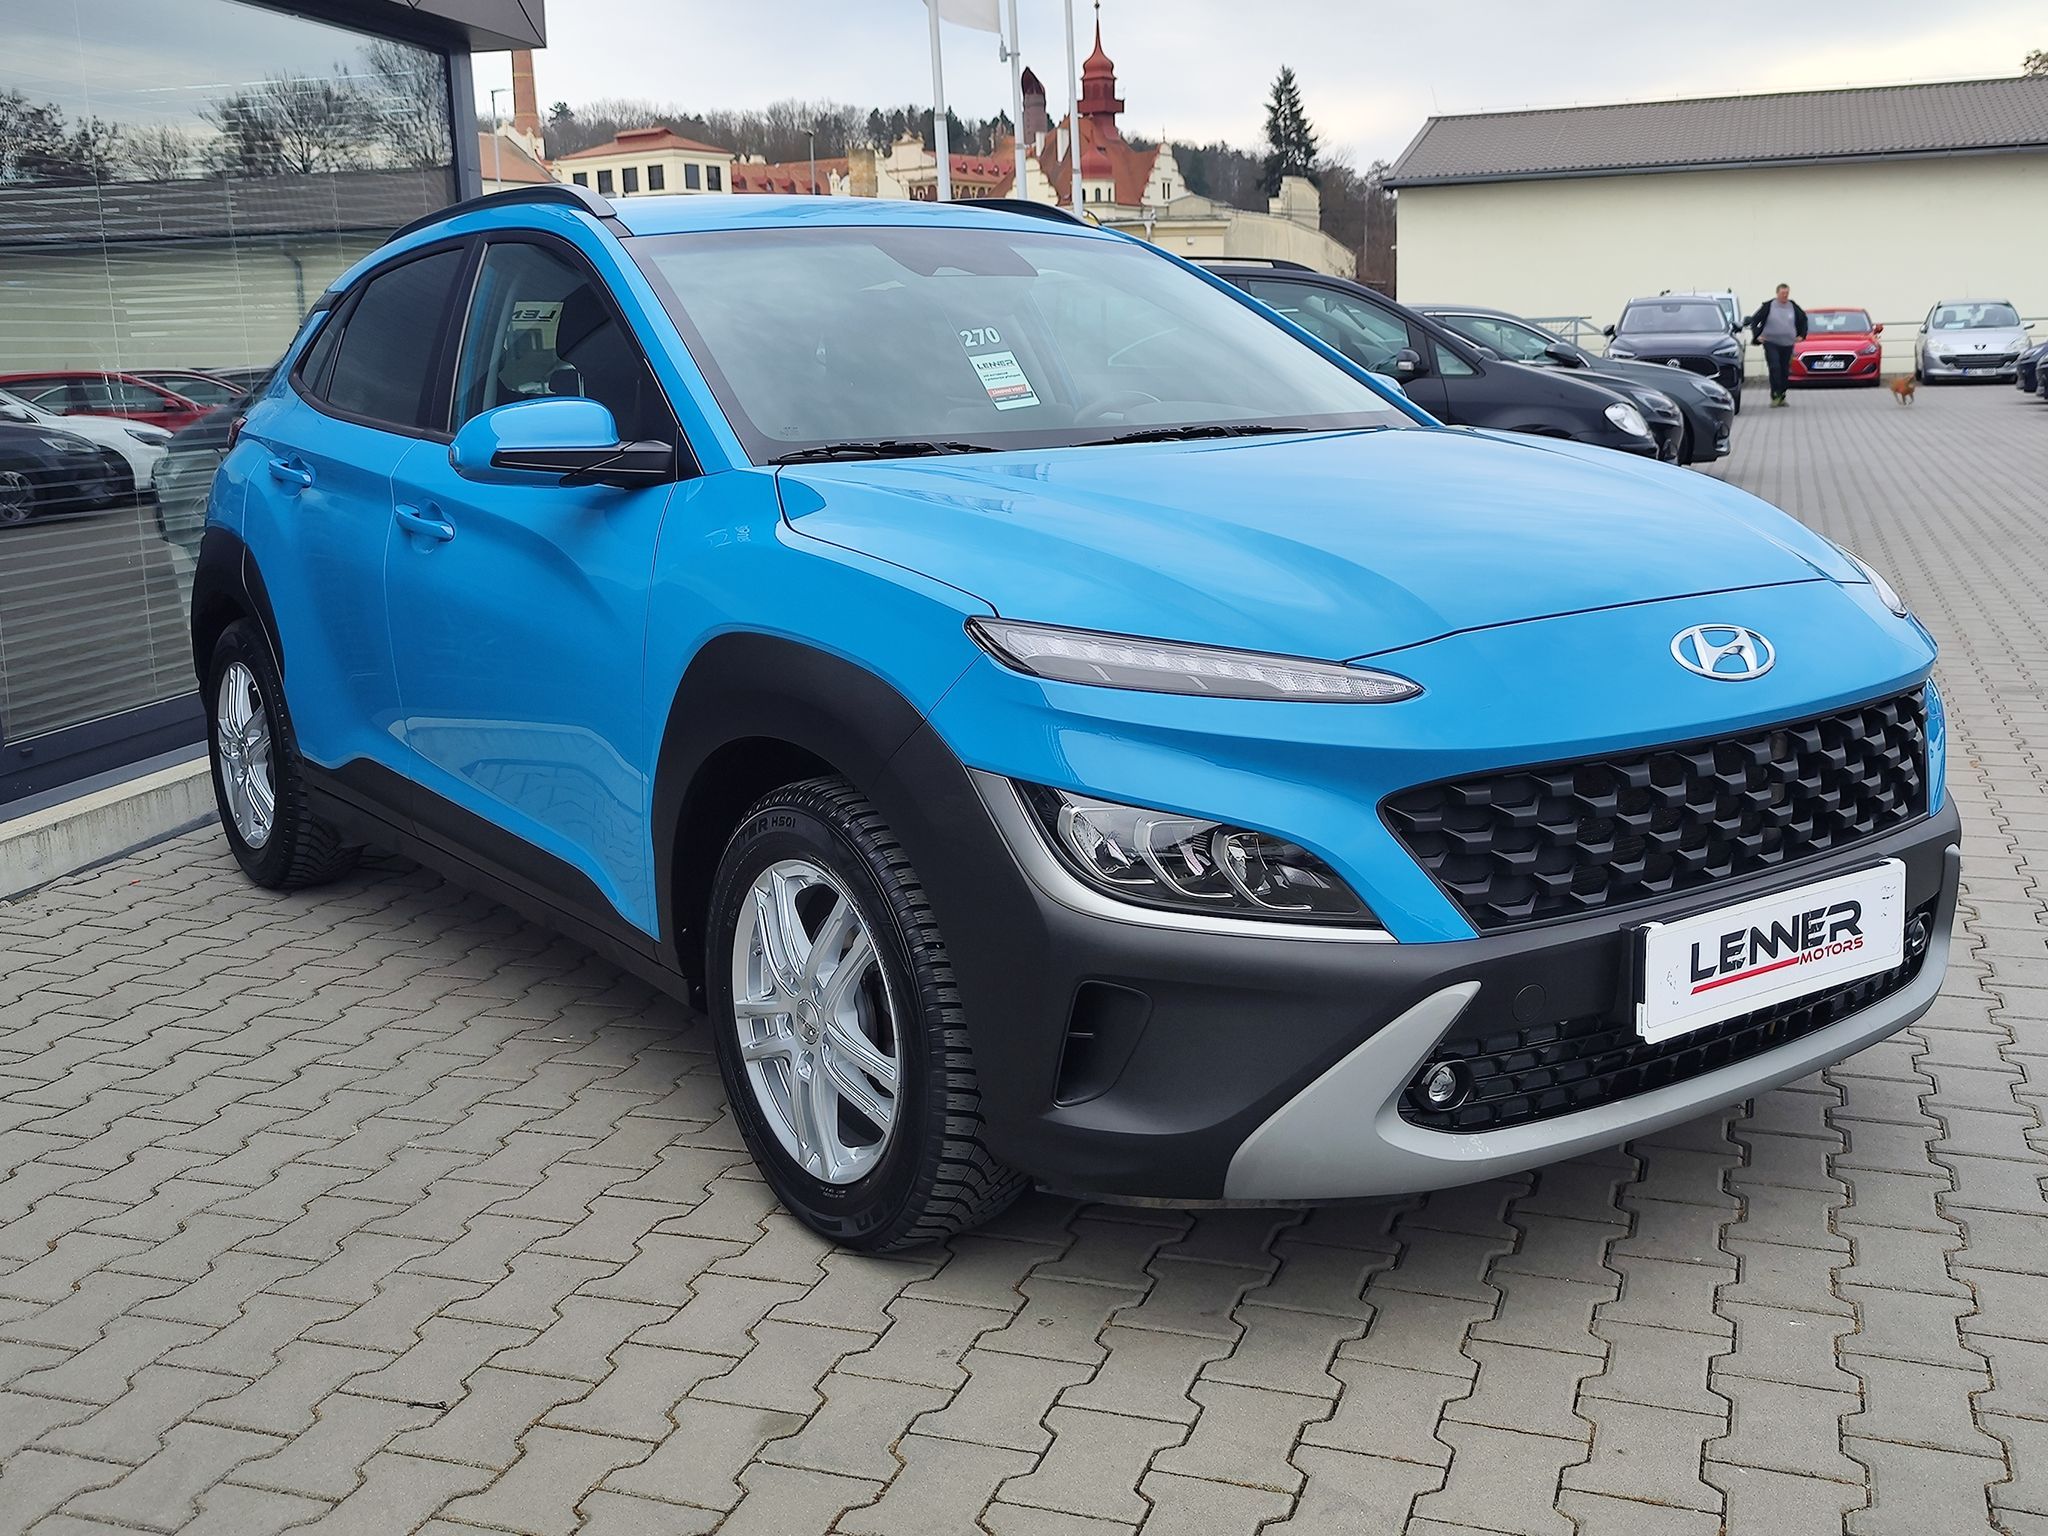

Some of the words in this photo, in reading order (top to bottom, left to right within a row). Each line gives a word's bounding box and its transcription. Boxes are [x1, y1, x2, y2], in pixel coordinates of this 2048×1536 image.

[960, 326, 1001, 347] 270
[1690, 900, 1863, 984] LENNER
[1799, 937, 1864, 965] MOTORS
